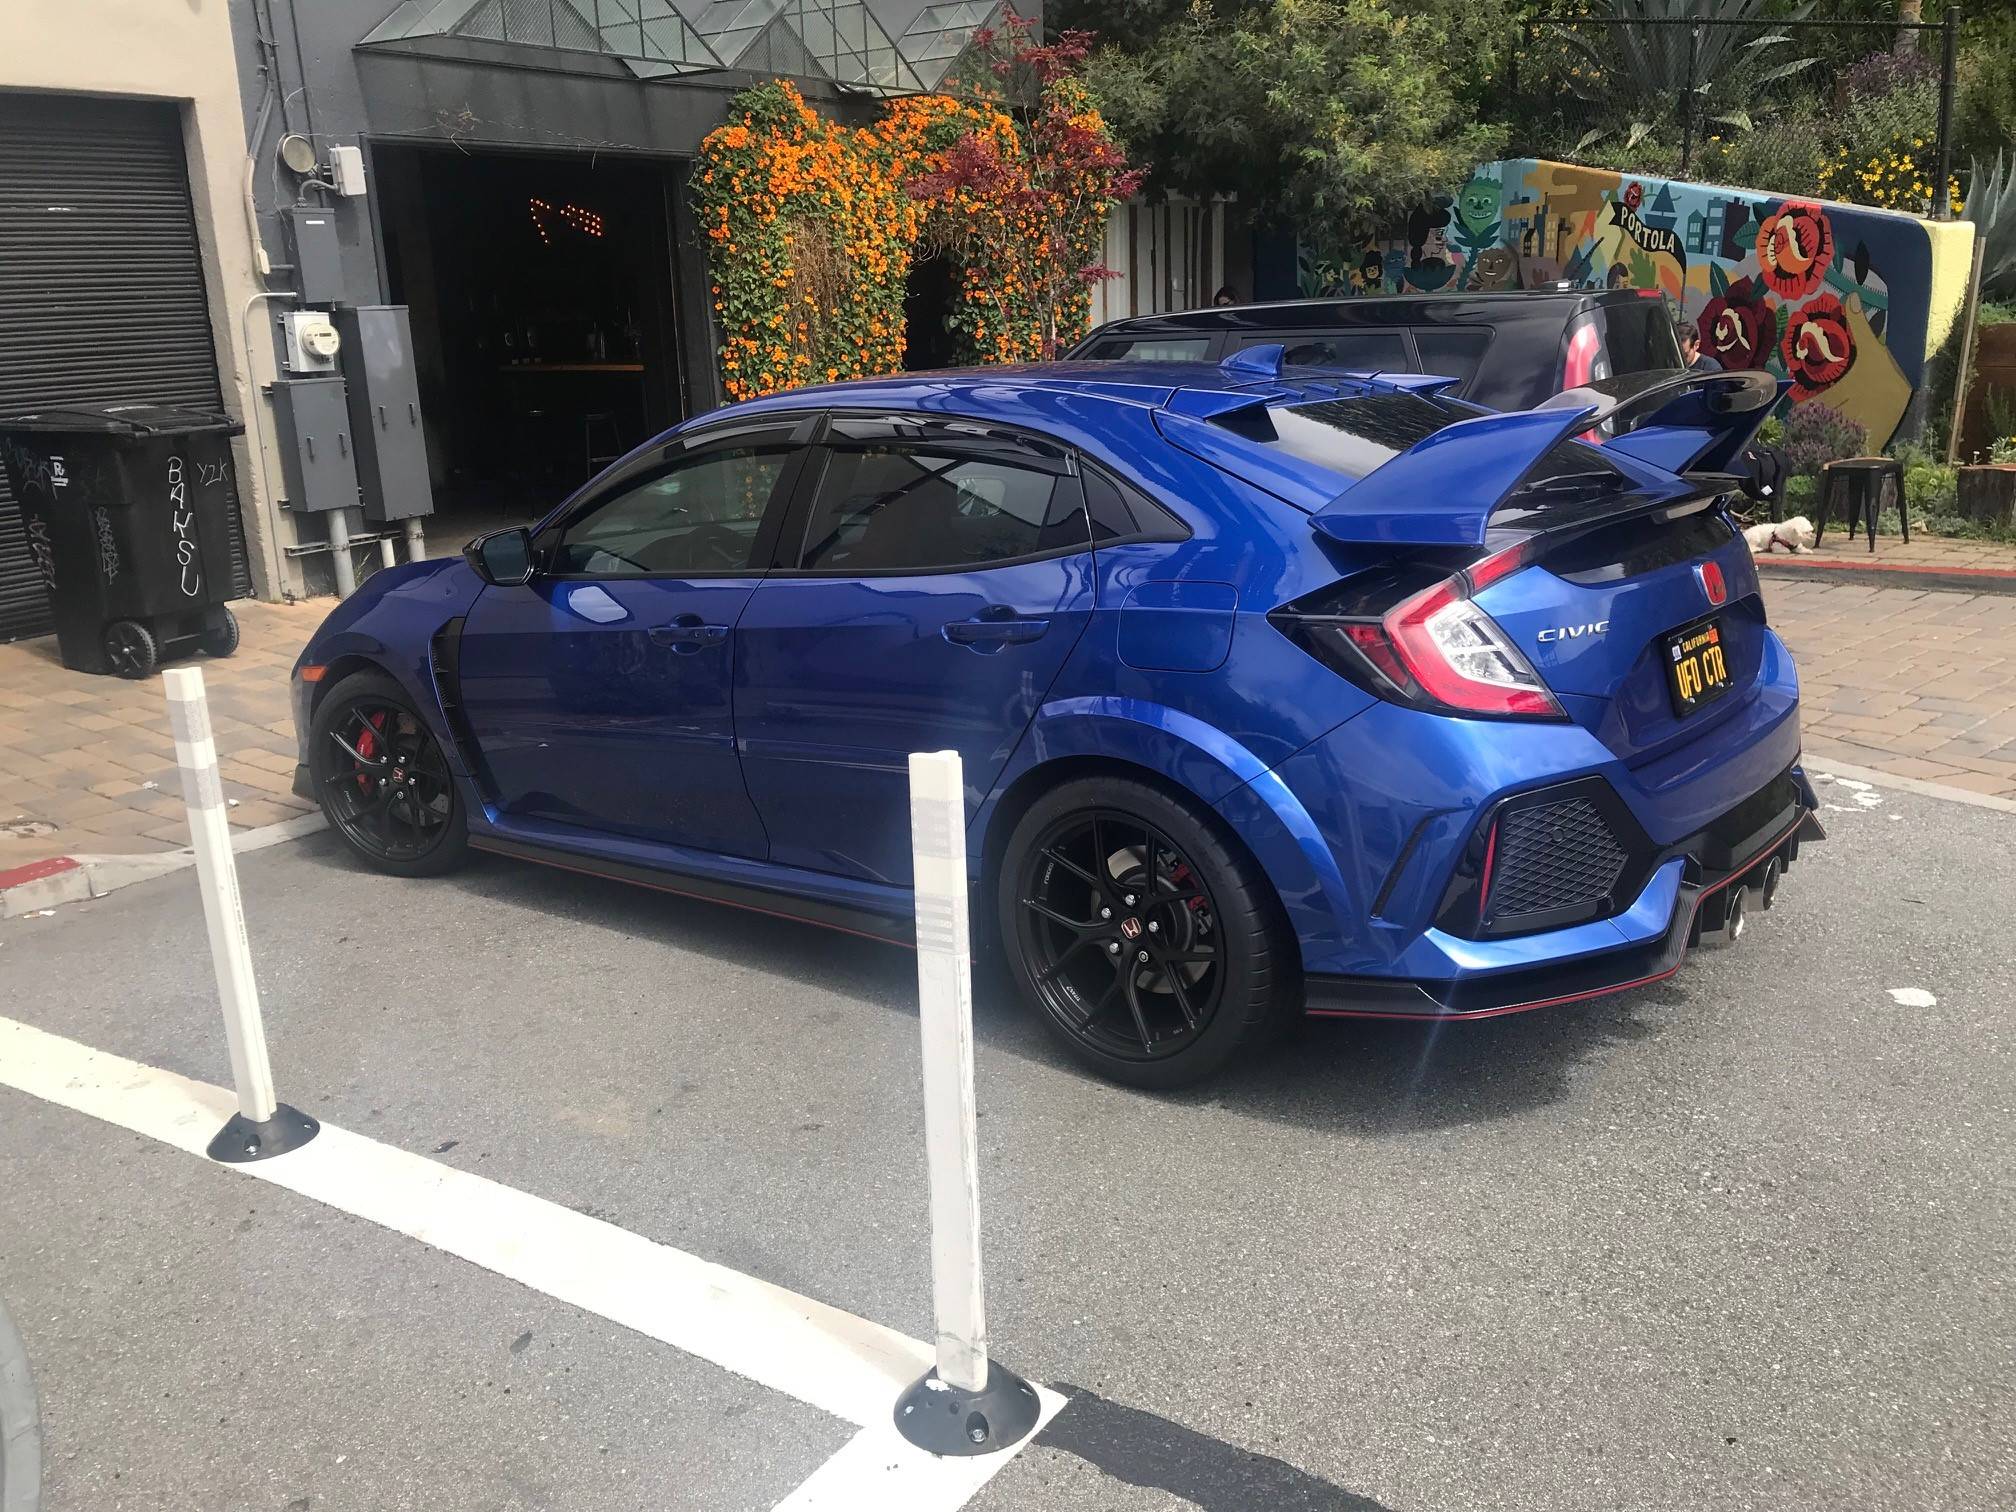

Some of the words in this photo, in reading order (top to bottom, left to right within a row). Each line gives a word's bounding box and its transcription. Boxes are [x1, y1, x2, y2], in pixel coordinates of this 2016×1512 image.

[1621, 207, 1675, 253] PORTOLA
[197, 457, 228, 487] Y2K
[1537, 620, 1610, 642] CIVIC
[1676, 656, 1702, 699] UFO
[1702, 645, 1727, 686] CTR
